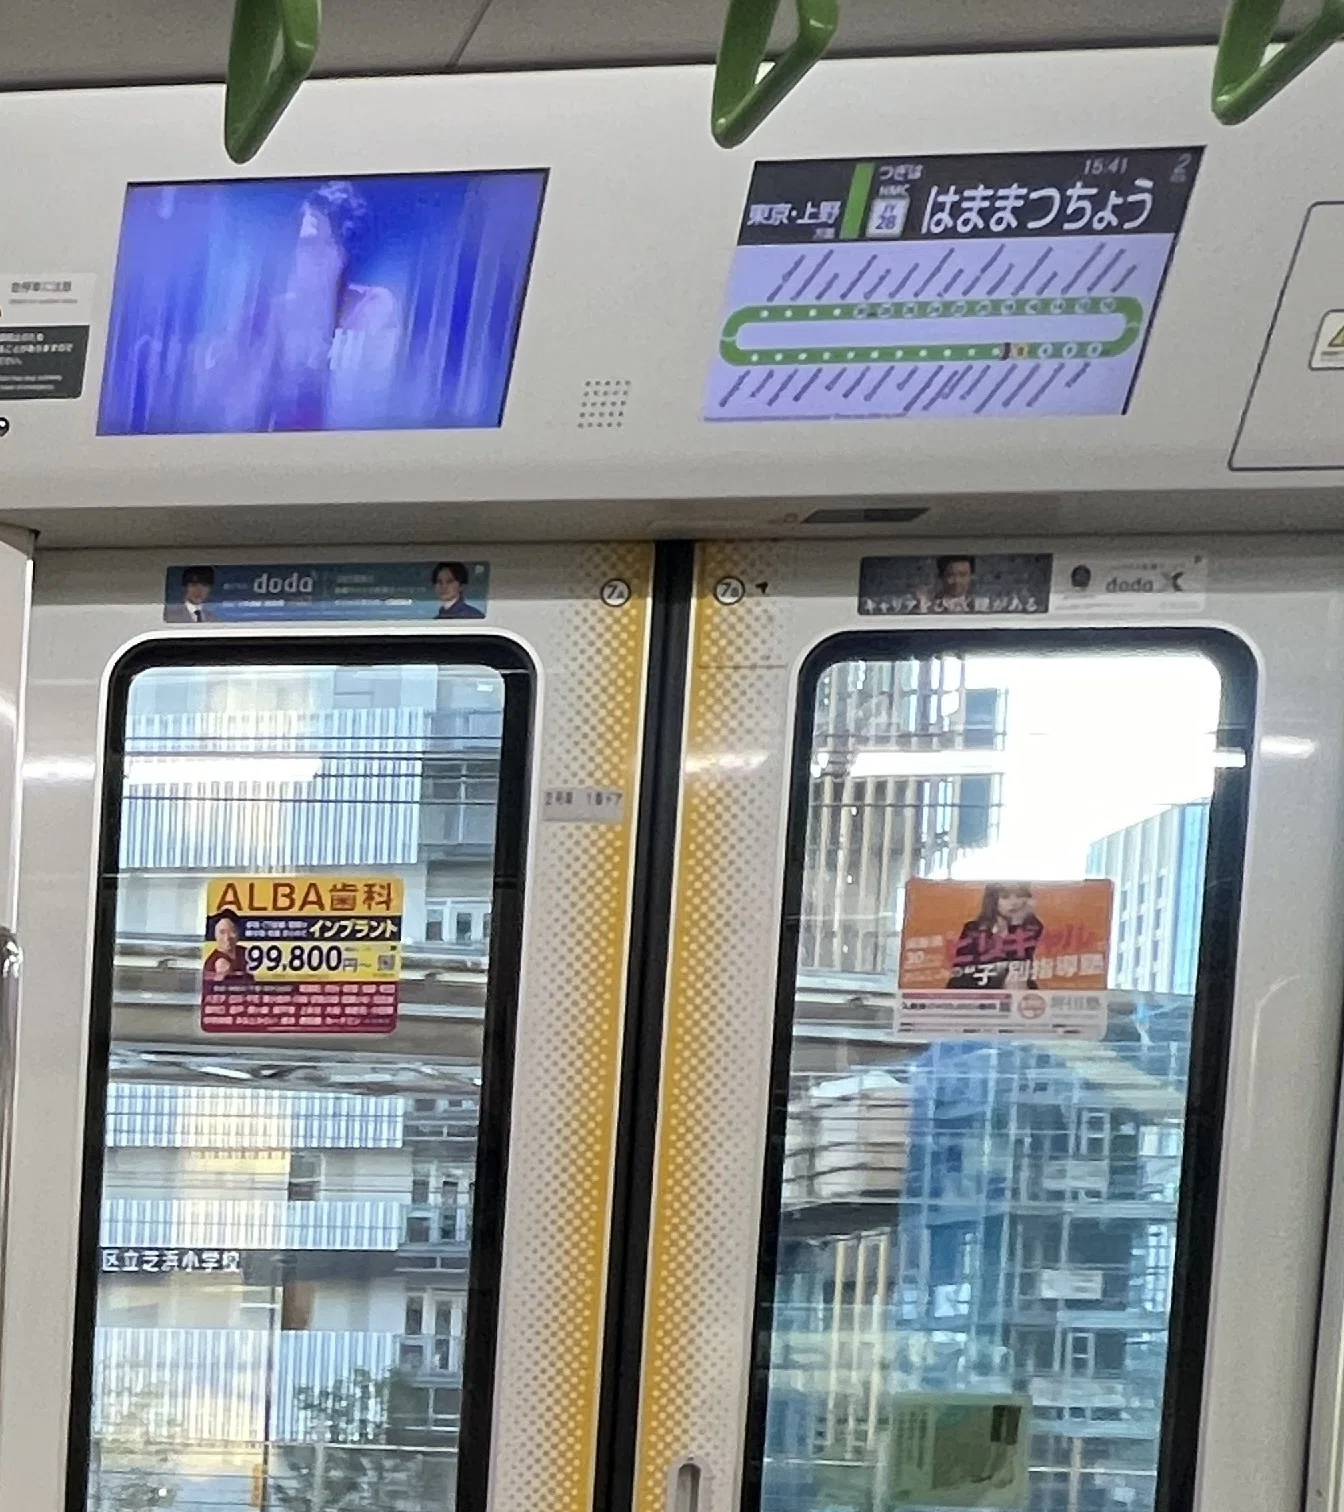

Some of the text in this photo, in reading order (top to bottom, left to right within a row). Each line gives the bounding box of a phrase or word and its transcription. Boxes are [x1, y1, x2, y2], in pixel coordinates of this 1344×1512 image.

[878, 164, 924, 180] つぎは
[747, 201, 841, 225] 東京・上野
[920, 177, 1154, 234] はままつちょう
[253, 573, 313, 593] doda
[1105, 577, 1153, 593] doda
[217, 882, 393, 911] ALBA歯科
[310, 919, 398, 938] インプラント
